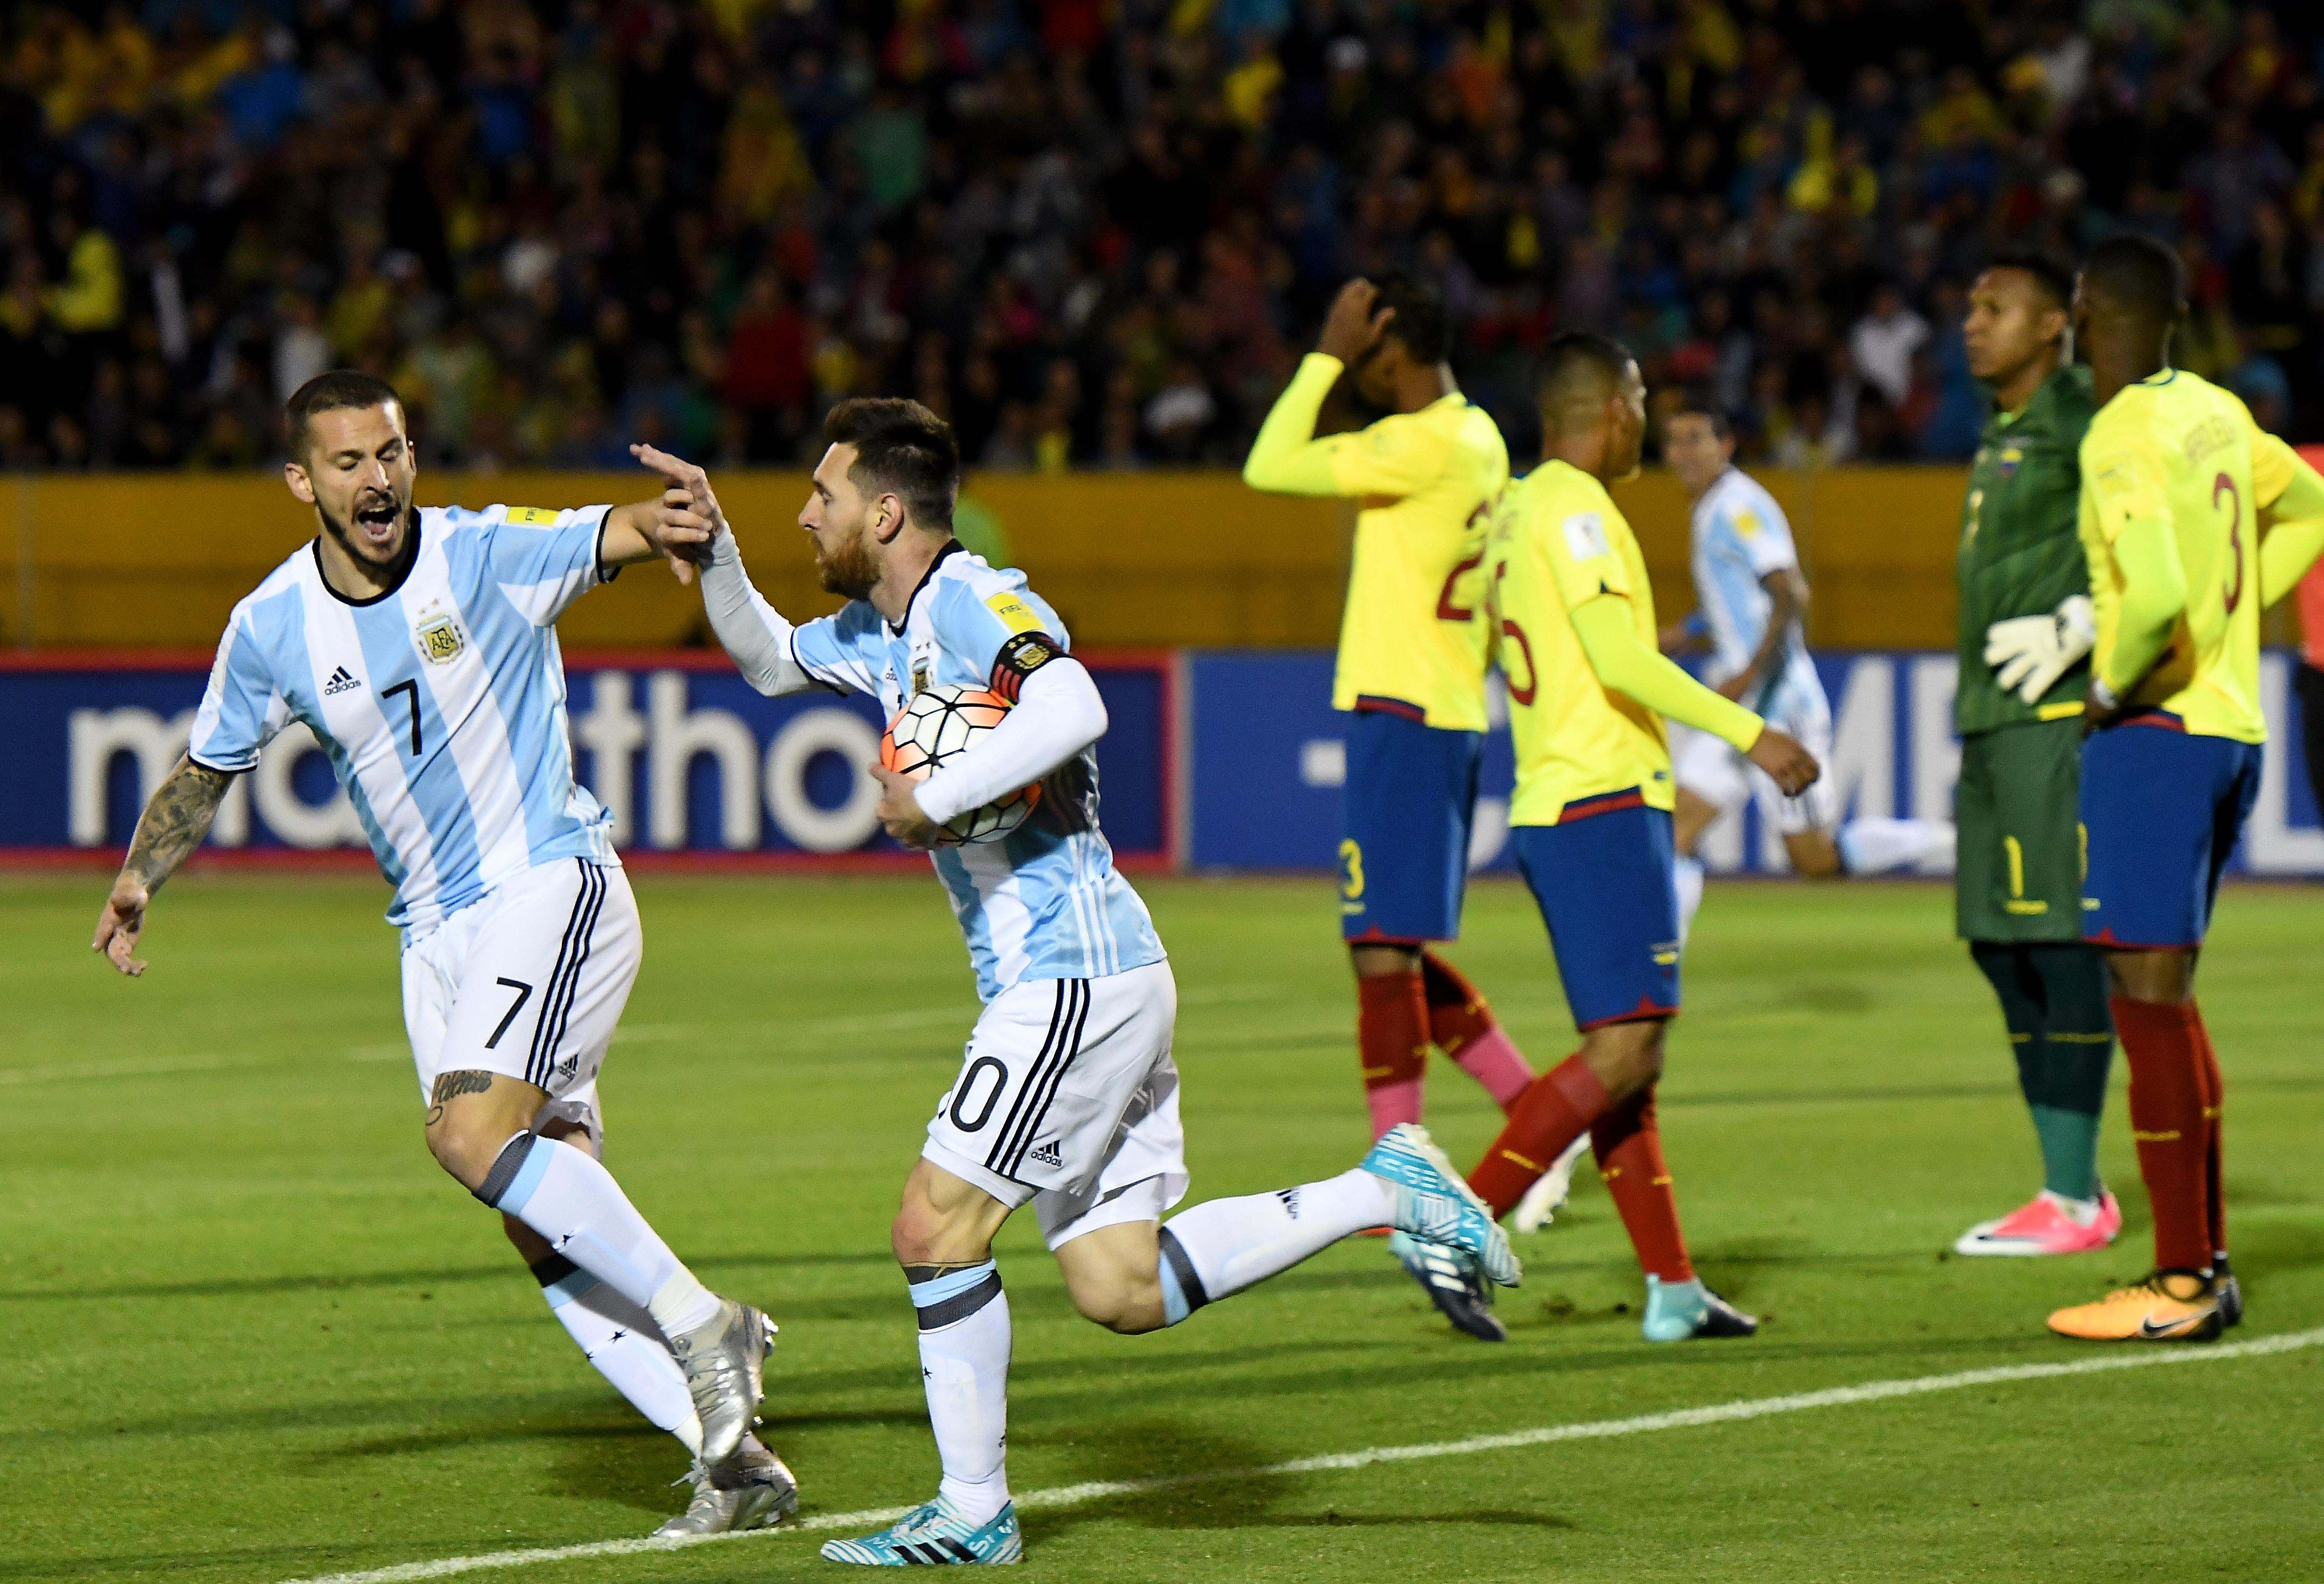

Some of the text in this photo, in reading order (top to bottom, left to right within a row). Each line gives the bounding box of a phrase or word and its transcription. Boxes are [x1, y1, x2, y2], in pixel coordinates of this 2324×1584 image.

[2212, 472, 2244, 615] 3
[324, 680, 362, 695] adidas
[381, 678, 423, 756] 7
[67, 668, 888, 853] matho
[1339, 838, 1365, 898] 3
[2004, 835, 2024, 897] 1
[484, 977, 533, 1049] 7
[938, 1056, 1008, 1132] 0
[1031, 1152, 1063, 1167] adidas
